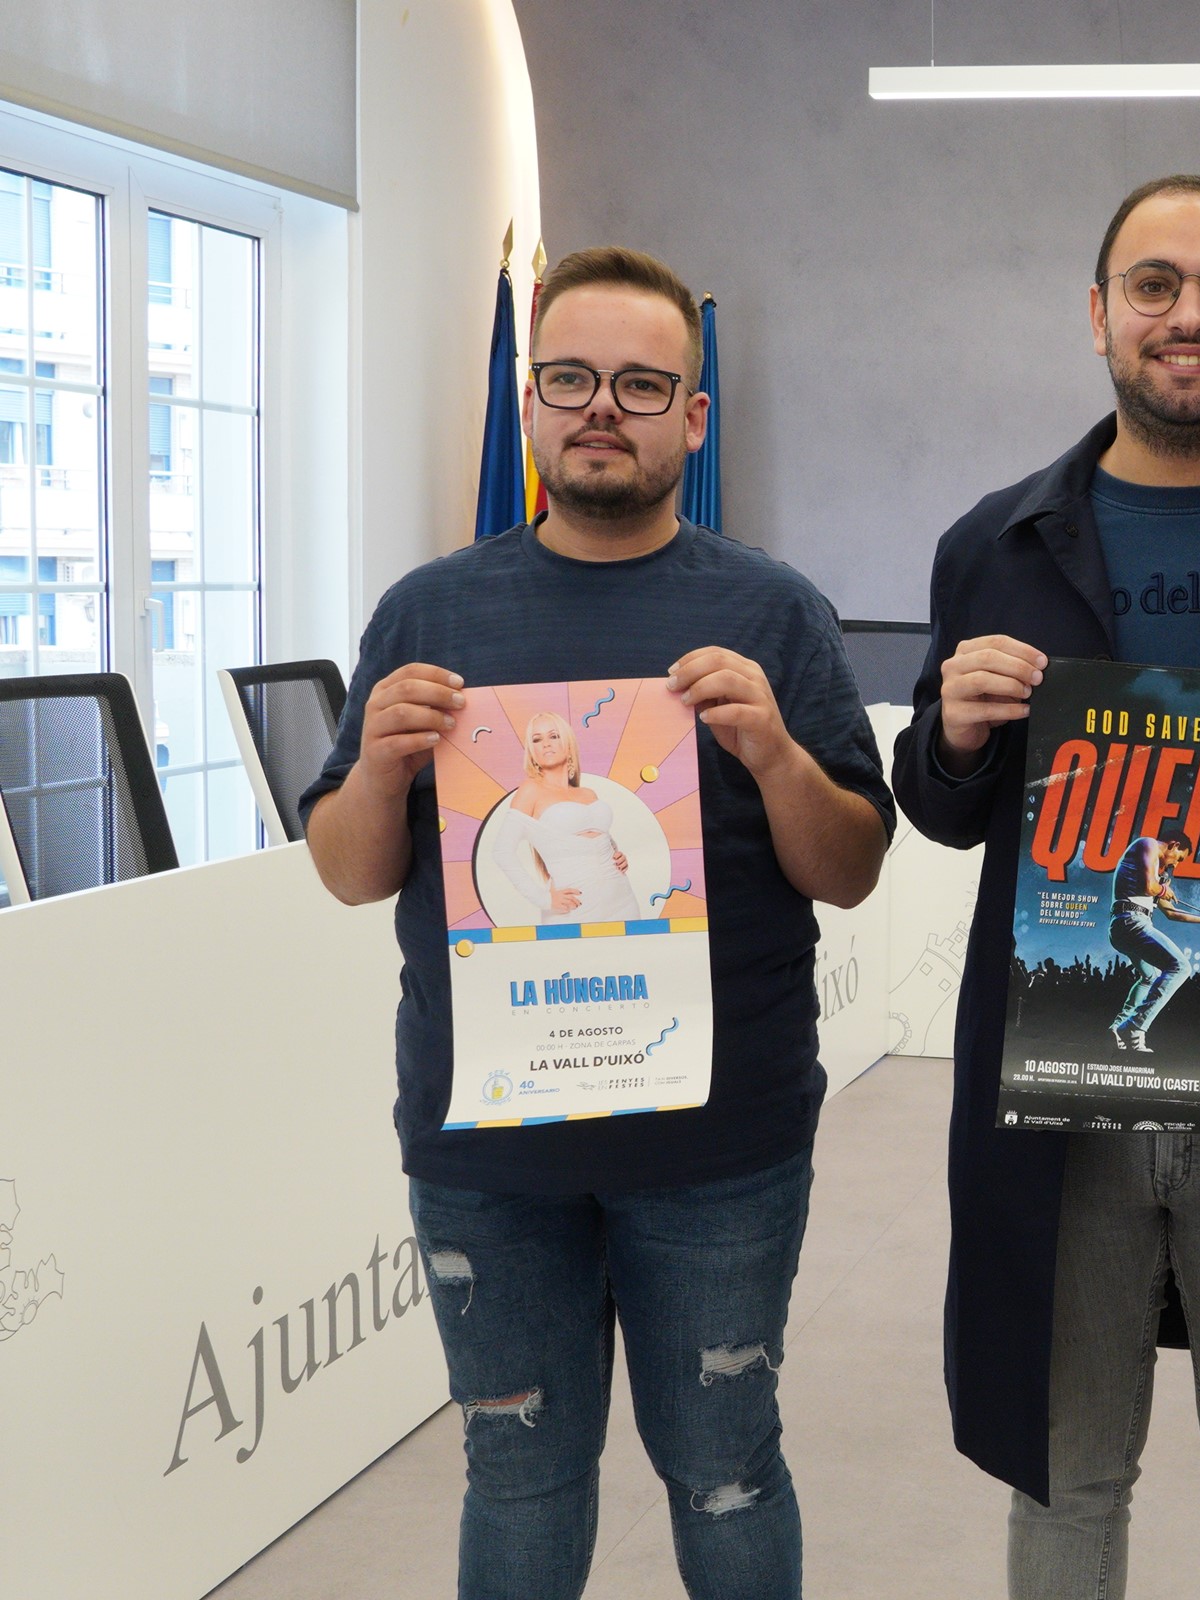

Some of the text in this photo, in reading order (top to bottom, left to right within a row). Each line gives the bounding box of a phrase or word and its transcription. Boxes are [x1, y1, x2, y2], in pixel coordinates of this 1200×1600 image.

[1086, 708, 1130, 737] GOD
[1051, 892, 1076, 902] MEJOR
[1077, 895, 1099, 903] SHOW
[1040, 900, 1088, 911] SOBRE QUEEN
[1039, 909, 1053, 917] DEL
[815, 934, 859, 1024] ixó
[510, 972, 649, 1008] LA HÚNGARA
[511, 1001, 651, 1016] EN CONCIERTO
[549, 1026, 624, 1038] 4 DE AGOSTO
[569, 1041, 592, 1049] ZONA
[606, 1038, 637, 1047] CARPAS
[529, 1050, 645, 1071] LA VALL D'UIXÓ
[1086, 1063, 1109, 1071] ESTADIO
[1024, 1060, 1079, 1076] 10 AGOSTO
[519, 1080, 535, 1089] 40
[1086, 1072, 1099, 1085] LA
[1100, 1073, 1125, 1087] VALL
[1126, 1075, 1161, 1090] D'UIXÓ
